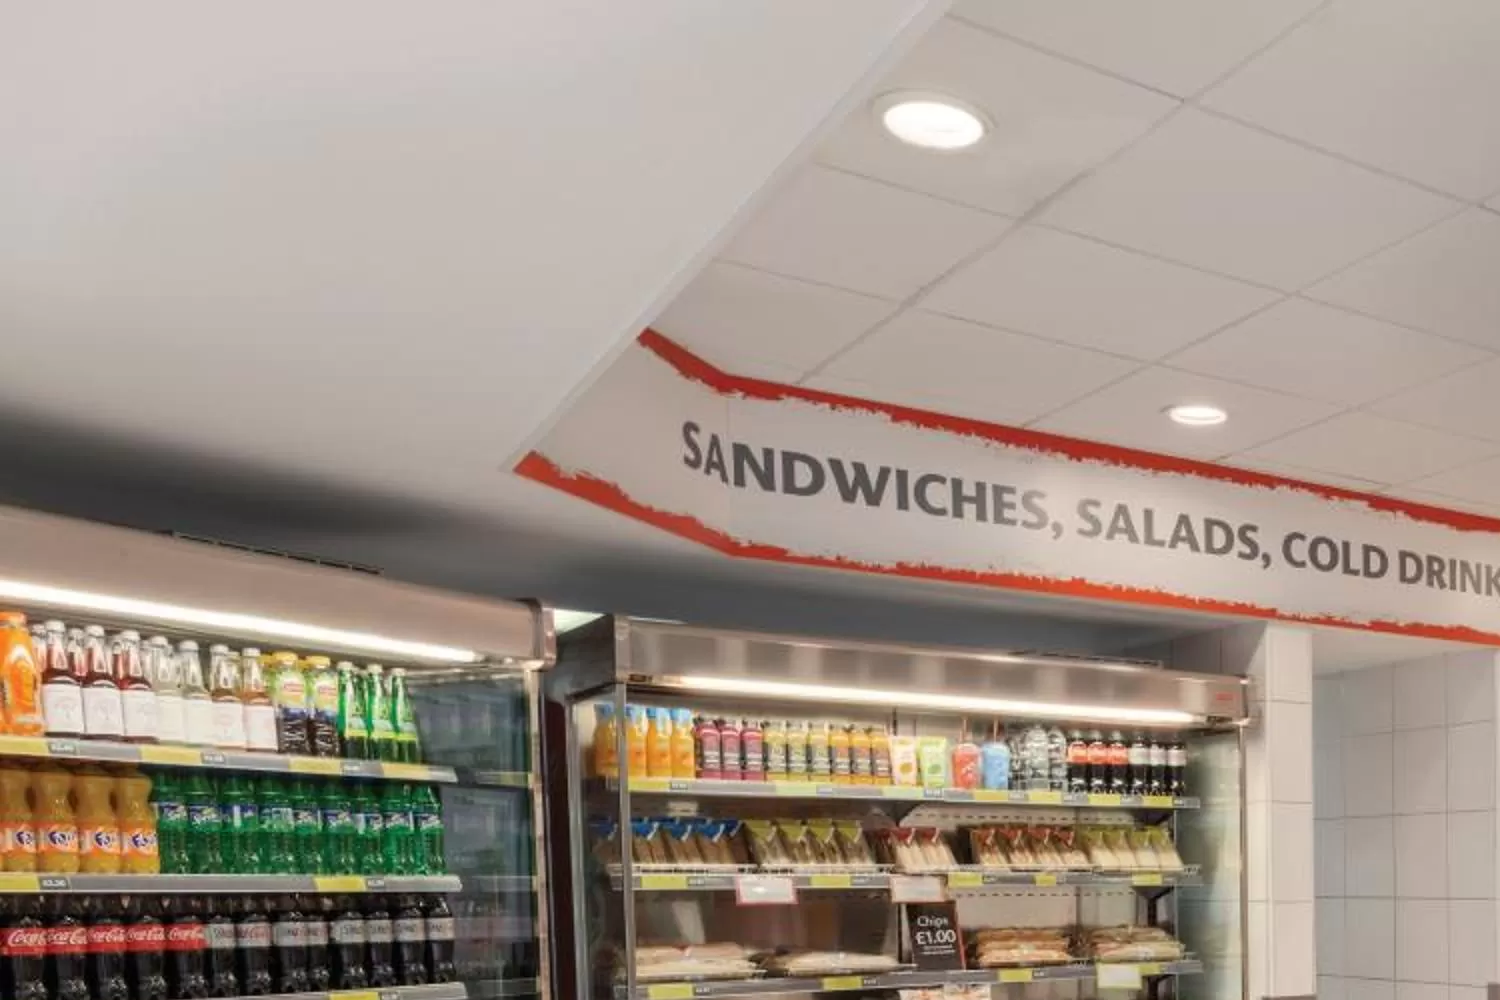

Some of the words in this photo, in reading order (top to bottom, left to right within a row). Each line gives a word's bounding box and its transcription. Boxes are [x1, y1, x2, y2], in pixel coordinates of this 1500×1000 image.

[682, 421, 1064, 539] SANDWICHES,
[1076, 499, 1271, 568] SALADS,
[1282, 531, 1388, 579] COLD
[917, 914, 949, 928] Chips
[915, 929, 957, 945] £1.00
